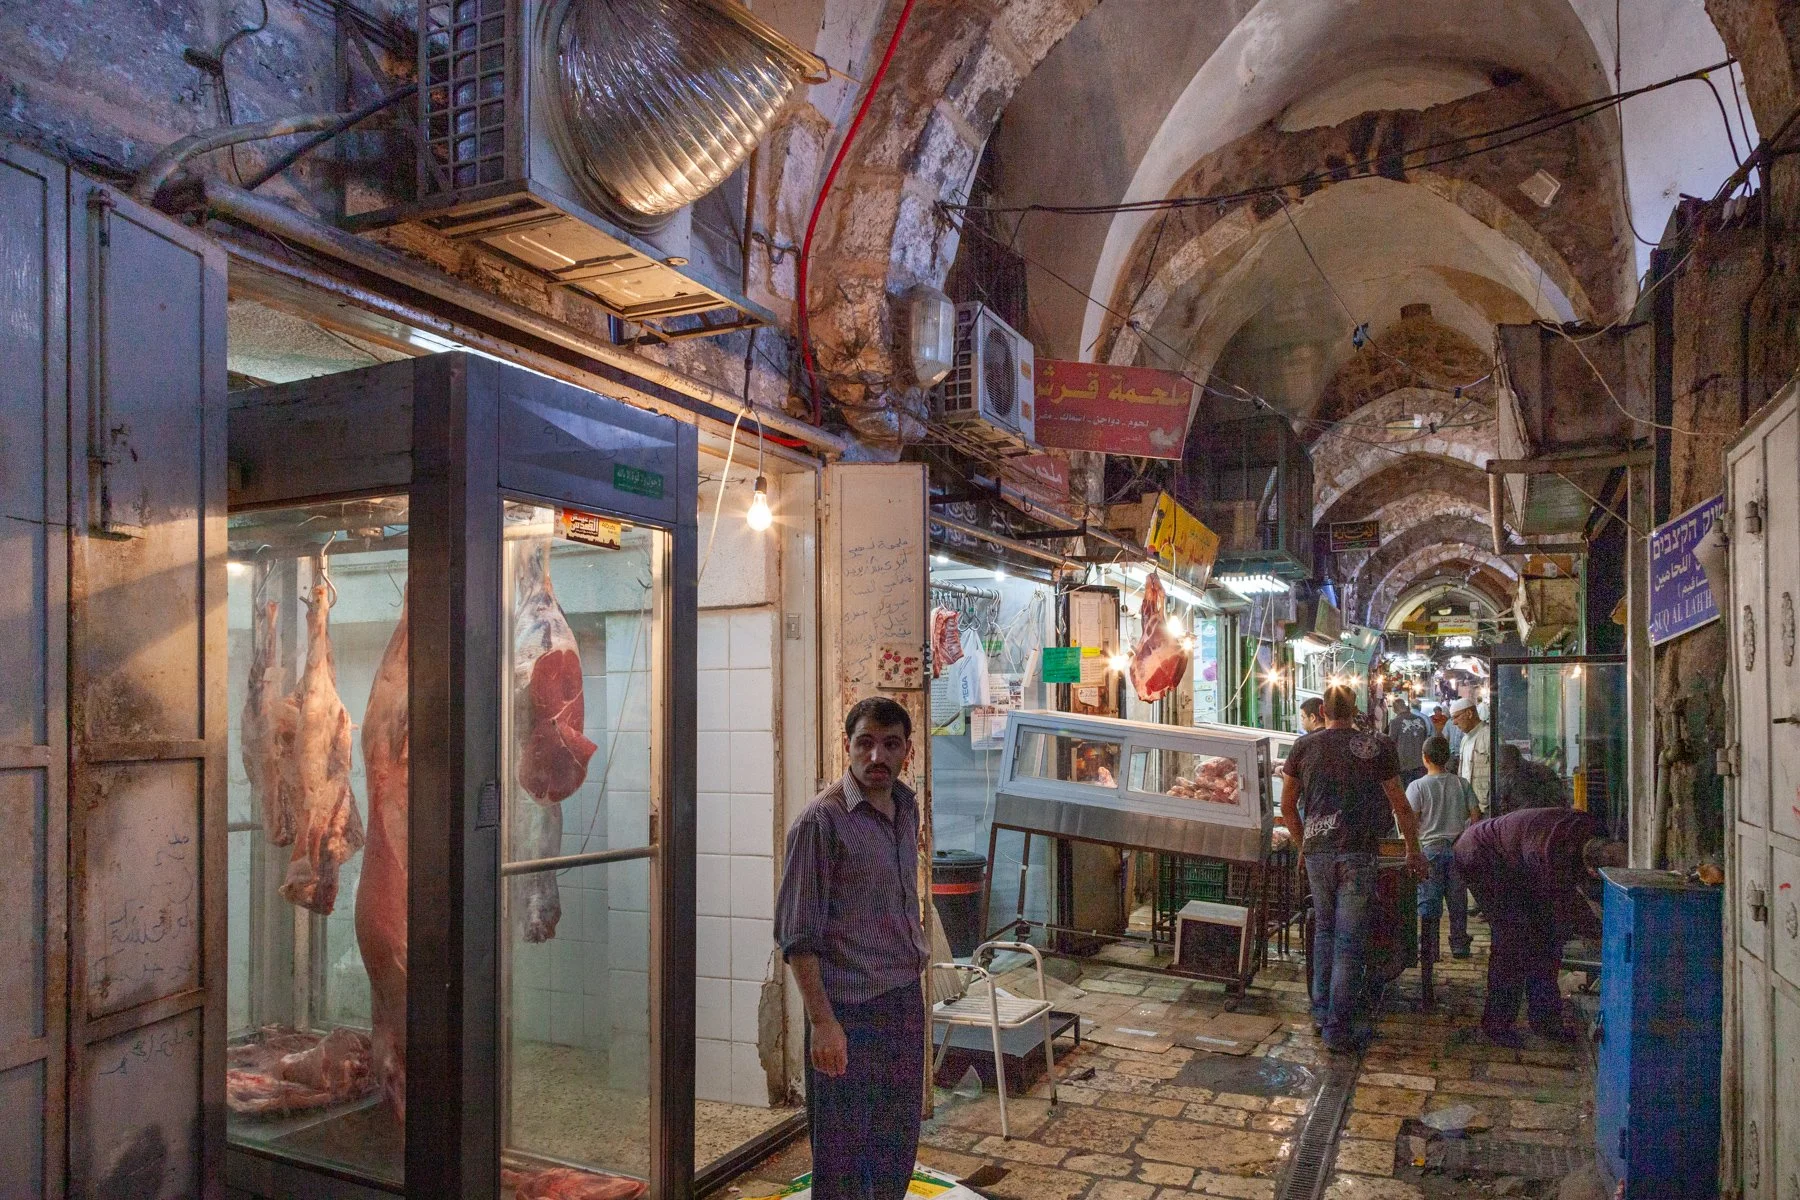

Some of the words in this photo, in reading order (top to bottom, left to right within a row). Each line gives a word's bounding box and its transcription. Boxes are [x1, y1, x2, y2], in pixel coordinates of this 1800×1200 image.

[1108, 373, 1191, 406] ملحمة
[1653, 518, 1697, 560] הקצבים
[1654, 553, 1691, 592] اللحامين
[1654, 608, 1670, 632] SUQ
[1672, 603, 1683, 624] AL
